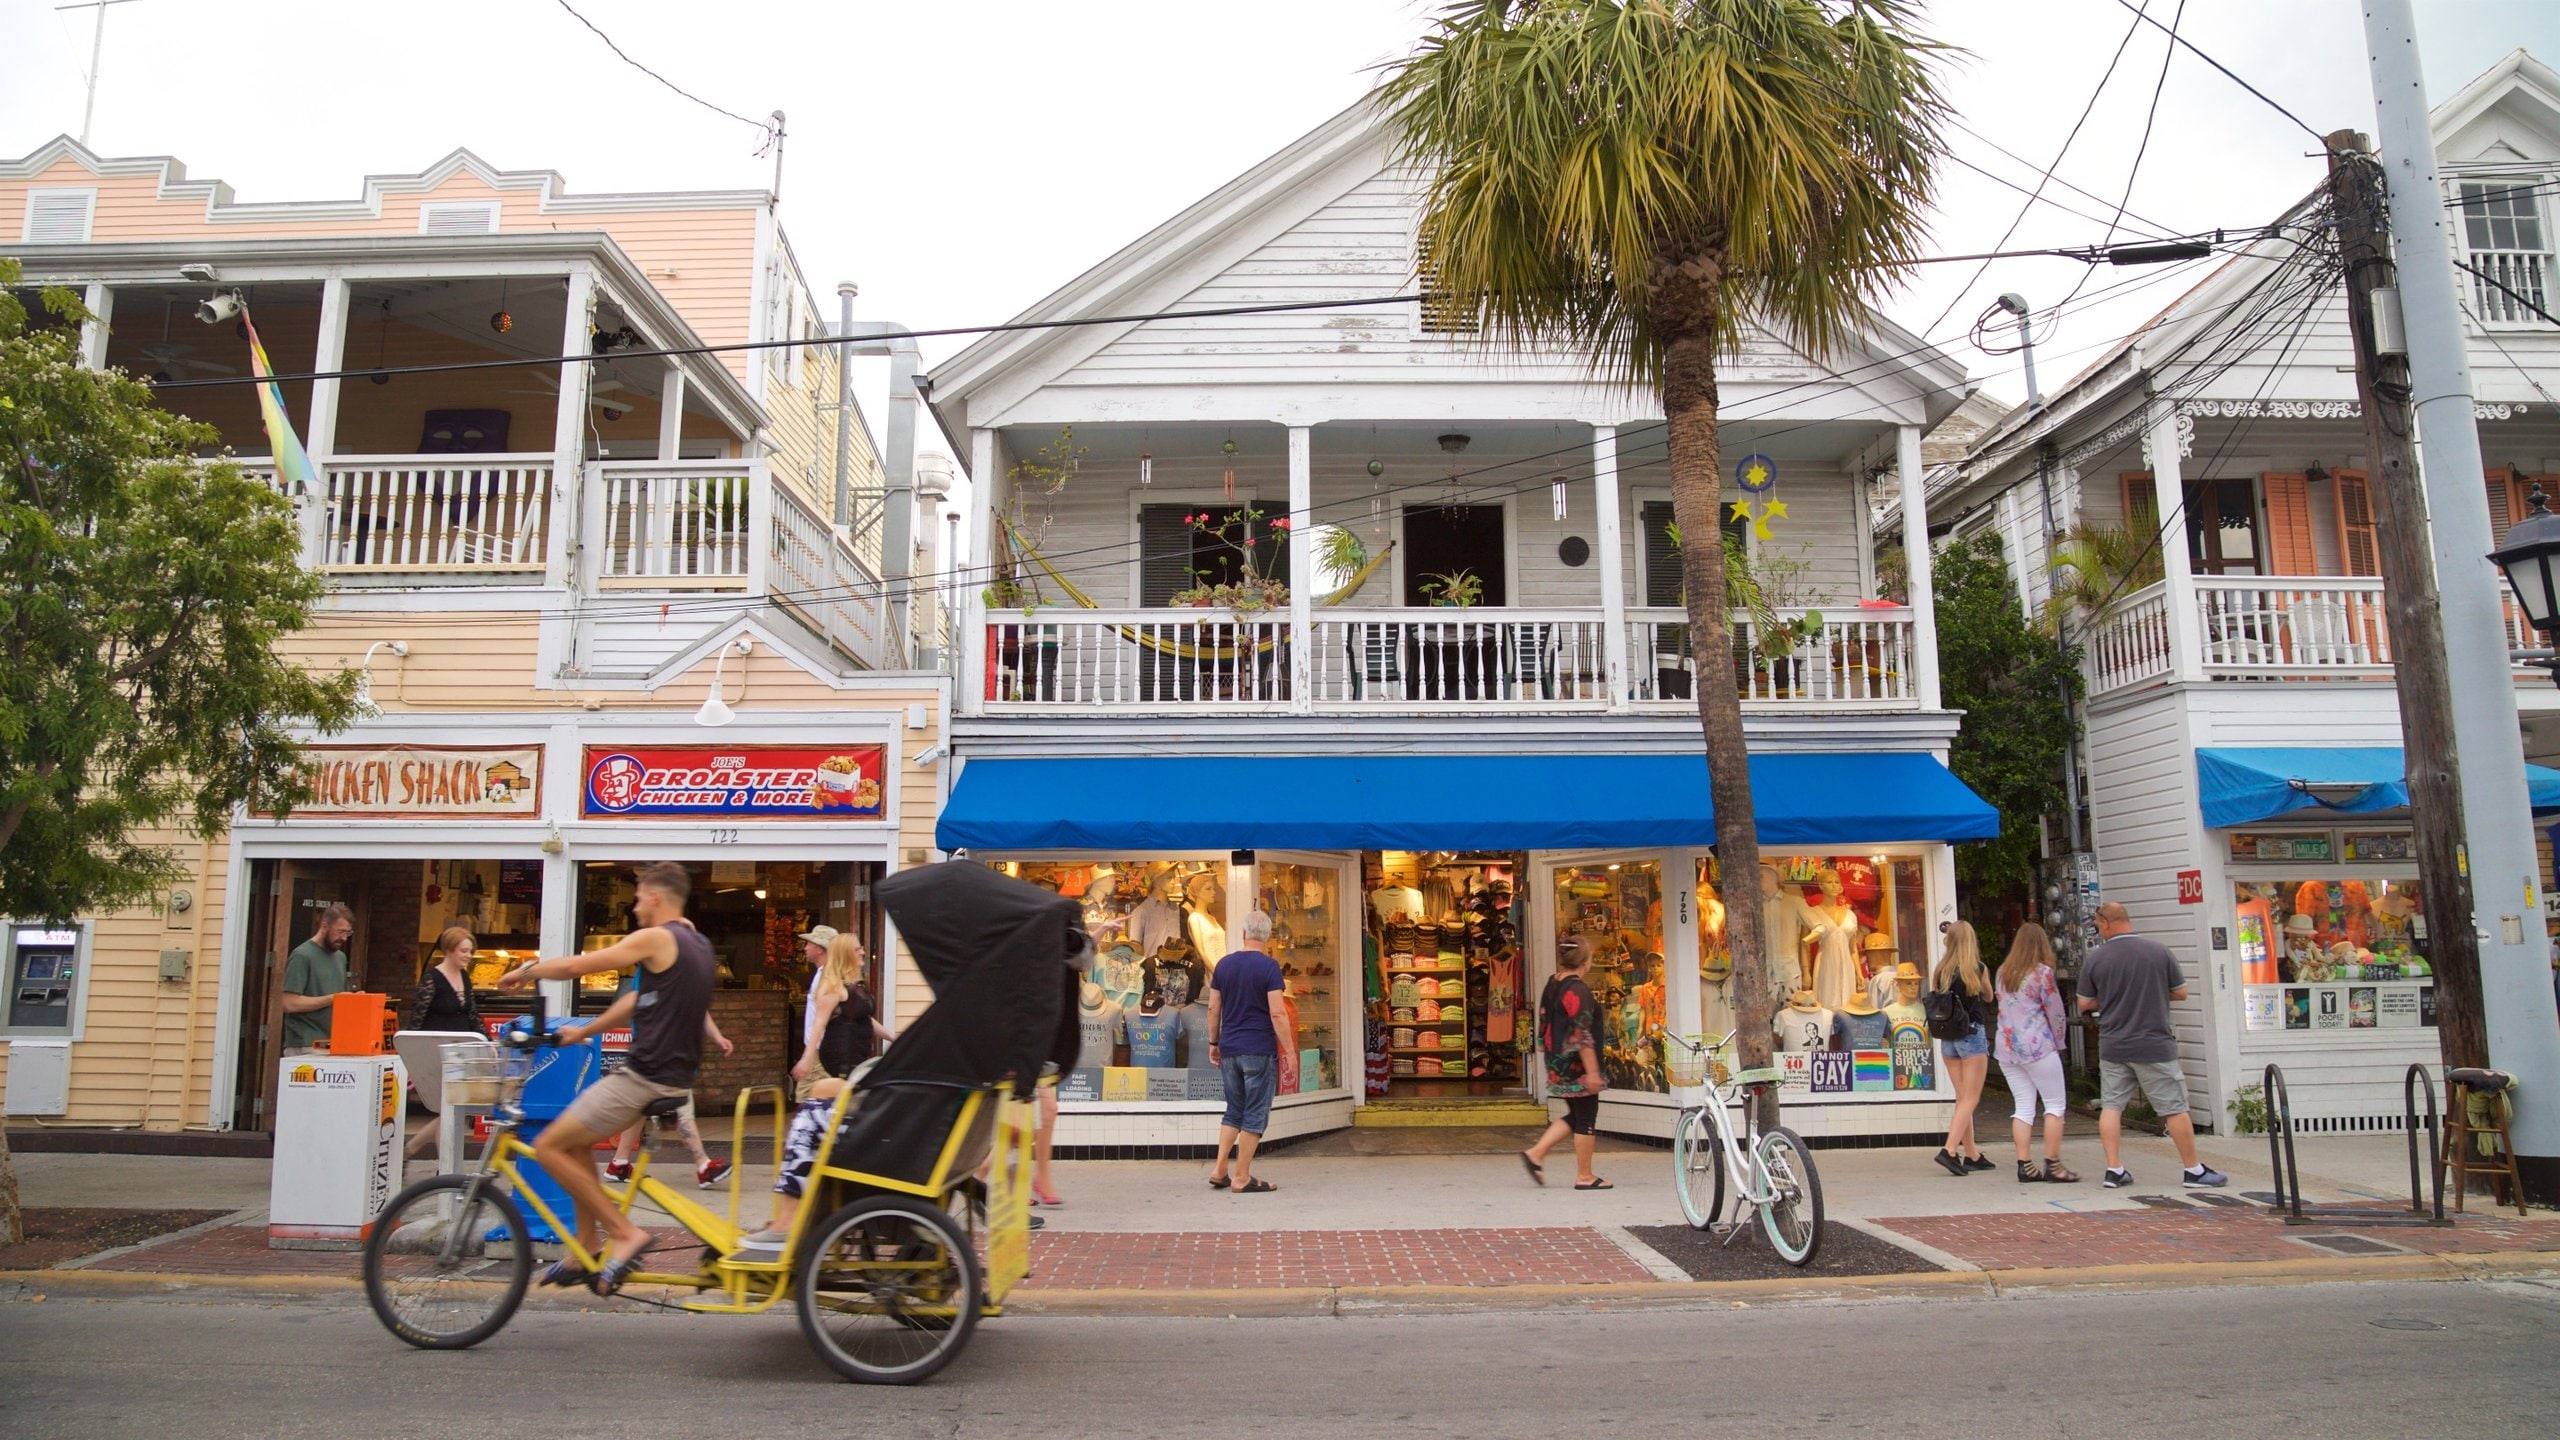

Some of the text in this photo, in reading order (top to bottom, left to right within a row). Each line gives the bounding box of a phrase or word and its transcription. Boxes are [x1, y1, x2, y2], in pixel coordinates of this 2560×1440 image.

[711, 757, 746, 768] JOE'S
[399, 760, 482, 806] SHACK
[641, 770, 817, 788] BROASTER
[638, 791, 814, 805] CHICKEN & MORE
[711, 829, 739, 843] 722
[2295, 844, 2319, 855] MILE
[2178, 876, 2202, 898] FDC
[1895, 1049, 1931, 1057] SORRY
[1785, 1059, 1803, 1069] 40
[1895, 1058, 1932, 1066] GIRLS.
[289, 1068, 356, 1084] THE CITIZEN
[1813, 1061, 1850, 1085] GAY
[1905, 1066, 1923, 1074] I'M
[382, 1061, 395, 1108] THE
[375, 1116, 396, 1214] CITIZEN
